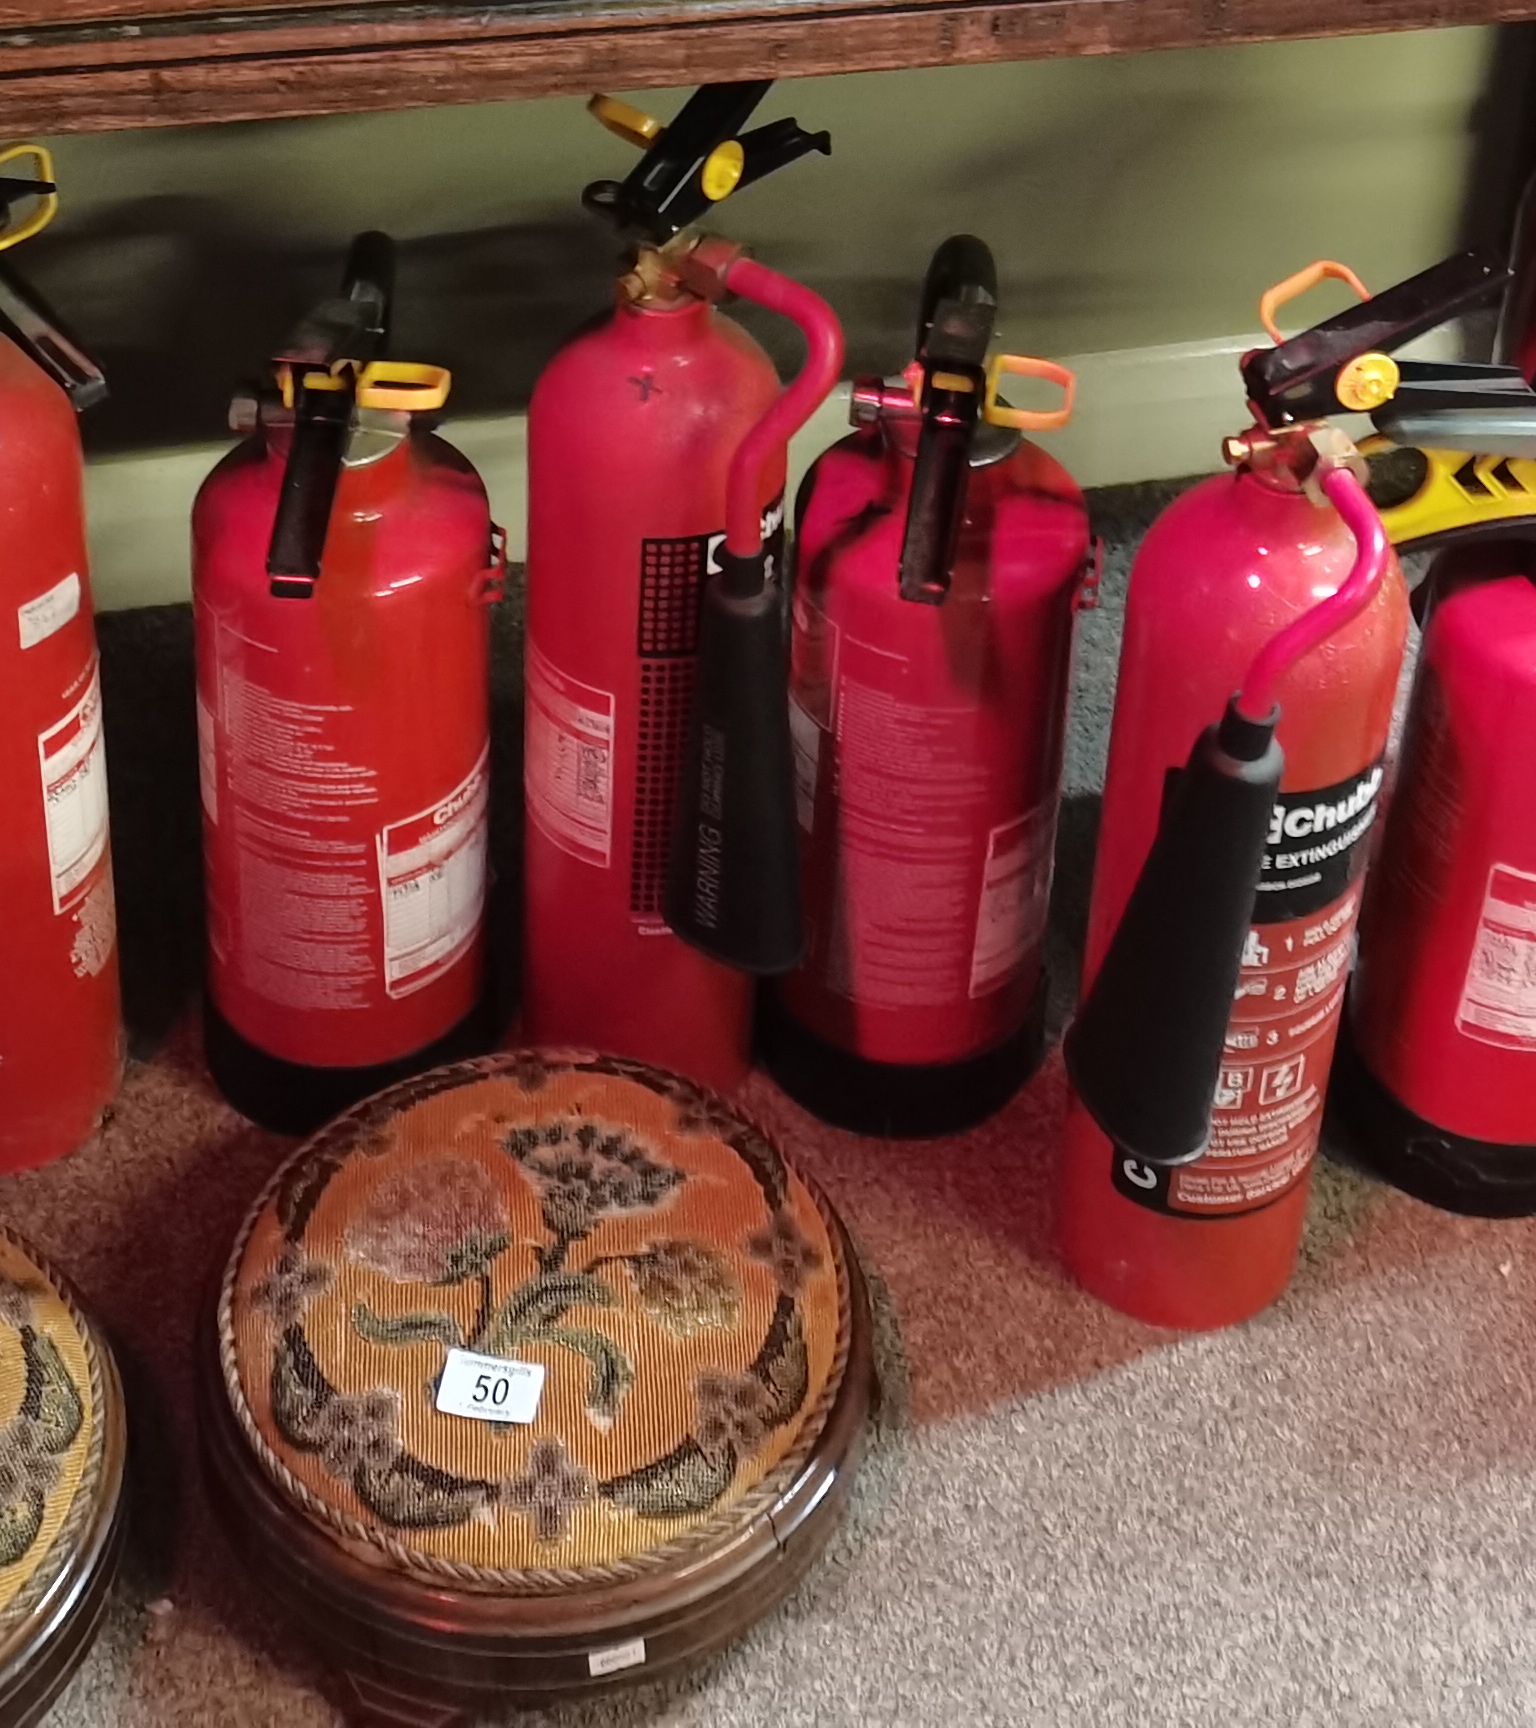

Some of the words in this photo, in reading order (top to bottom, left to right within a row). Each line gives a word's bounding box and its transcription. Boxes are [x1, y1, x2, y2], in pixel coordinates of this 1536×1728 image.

[695, 823, 722, 929] WARNING
[1273, 984, 1287, 1002] 2
[1266, 1029, 1280, 1046] 3
[471, 1373, 511, 1406] 50
